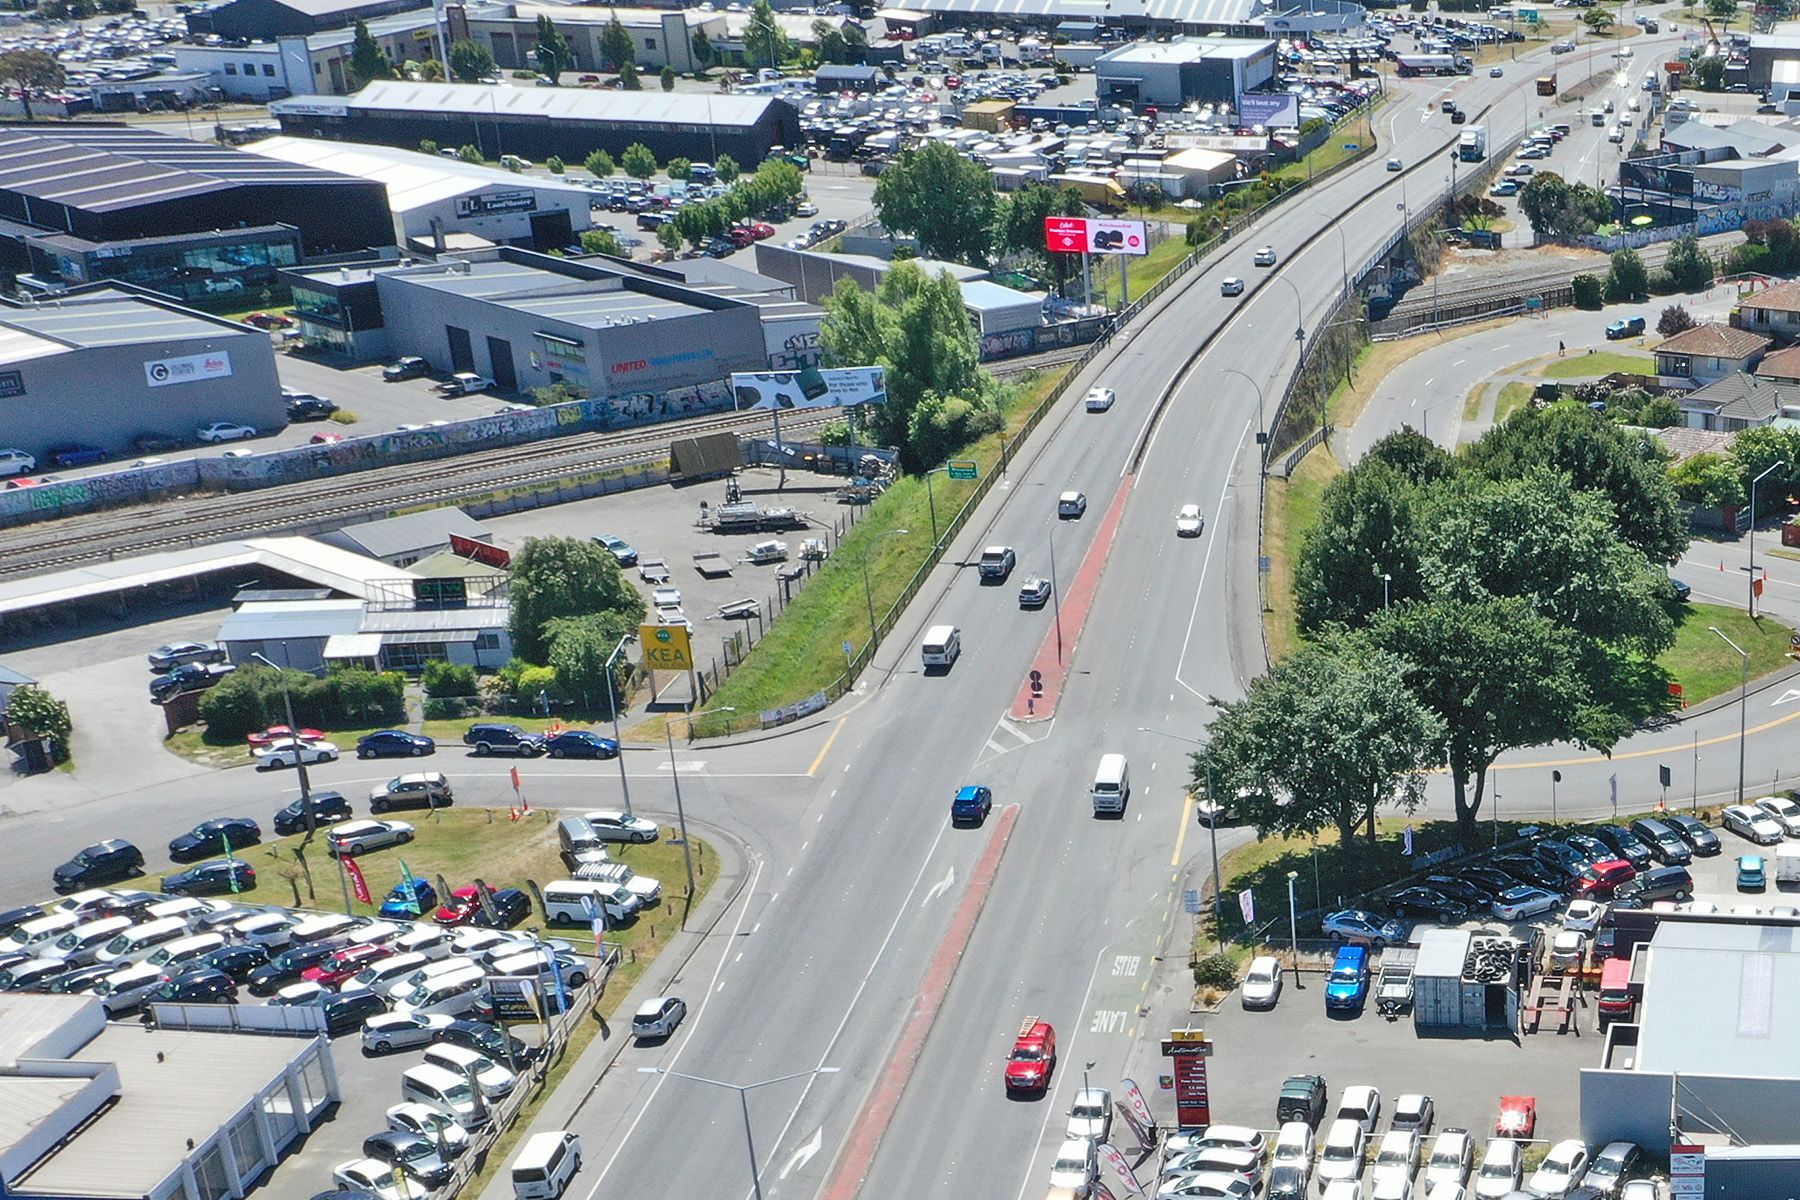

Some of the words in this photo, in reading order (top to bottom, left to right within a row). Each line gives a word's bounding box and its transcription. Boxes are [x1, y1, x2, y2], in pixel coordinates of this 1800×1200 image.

[611, 360, 647, 373] UNITED
[647, 648, 684, 661] KEA
[1112, 955, 1141, 977] BUS
[1090, 1010, 1128, 1033] LANE
[1127, 1087, 1148, 1121] WOF
[1106, 1152, 1136, 1187] WOF
